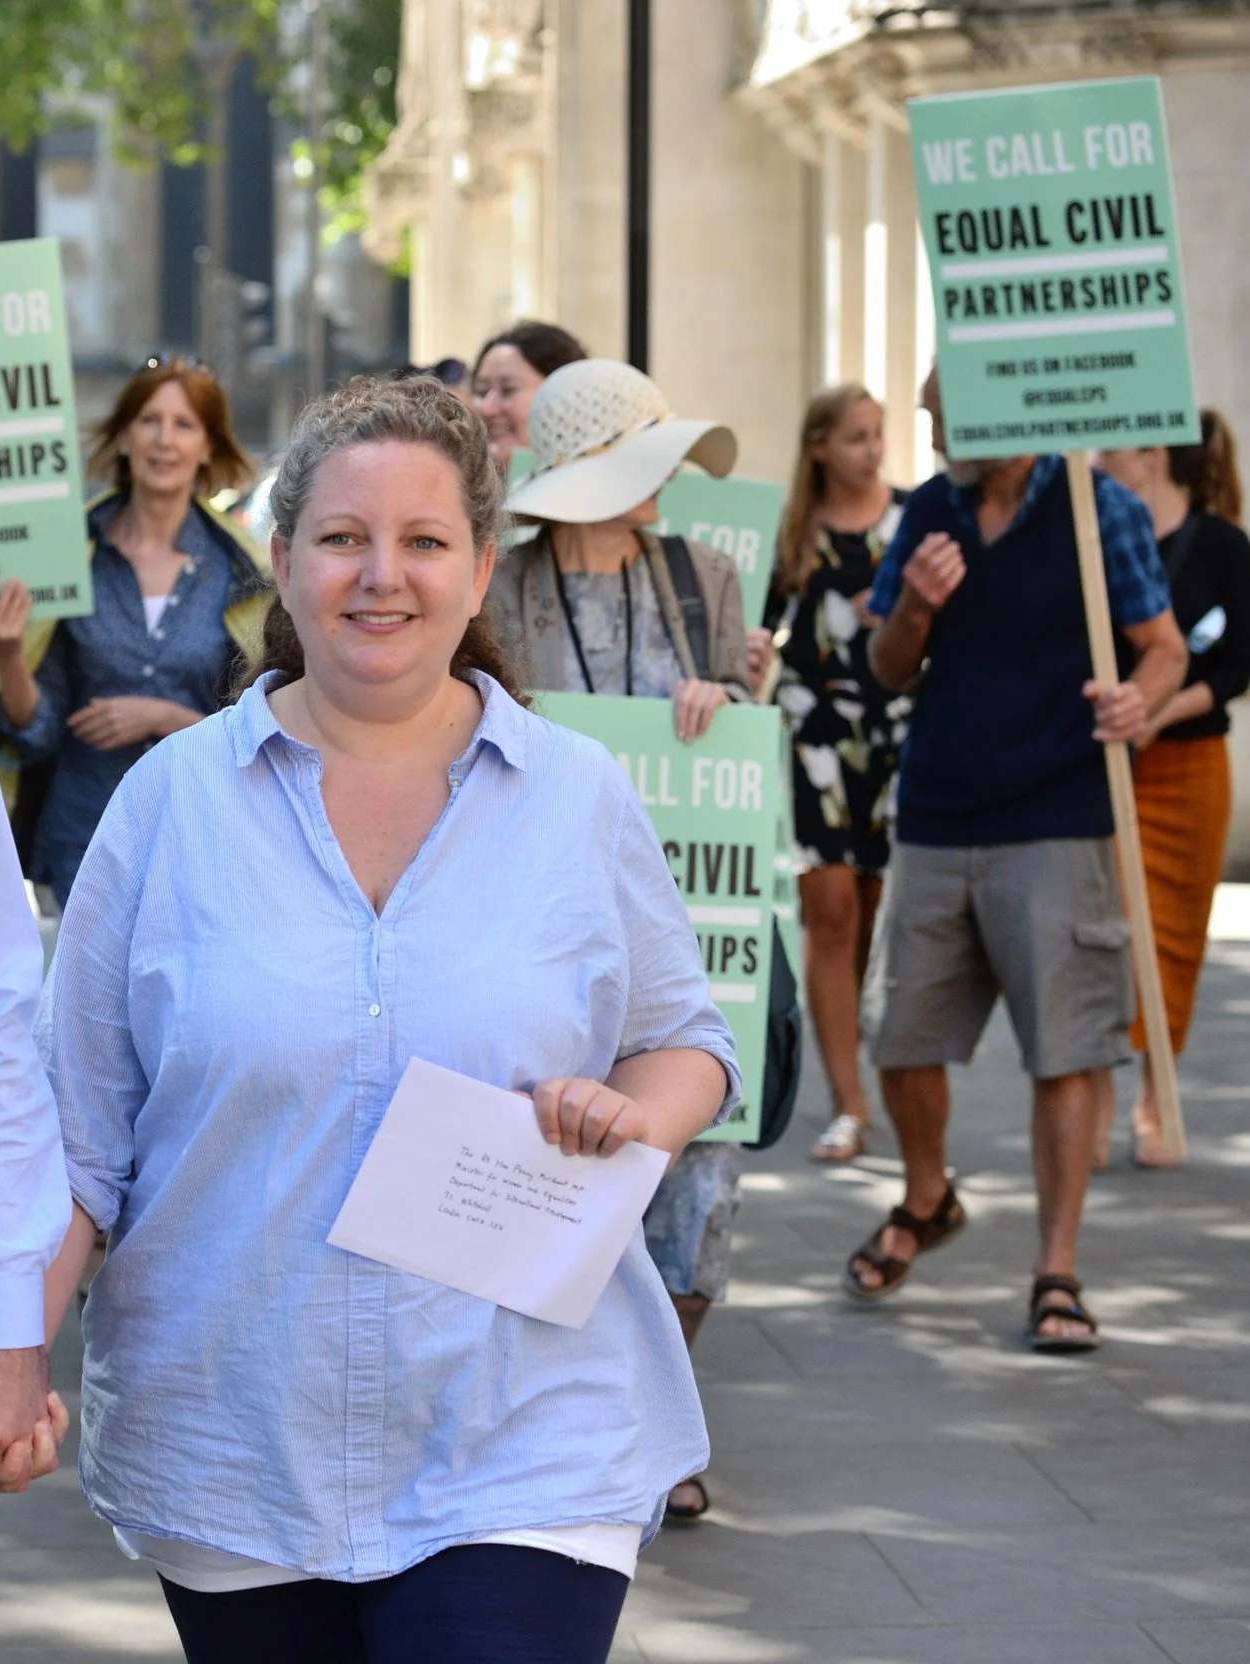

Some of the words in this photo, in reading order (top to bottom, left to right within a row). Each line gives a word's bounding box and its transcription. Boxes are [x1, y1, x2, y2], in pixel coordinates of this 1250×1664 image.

[921, 138, 977, 185] WE
[985, 130, 1076, 179] CALL
[1084, 121, 1155, 170] FOR
[935, 205, 1052, 255] EQUAL
[1065, 192, 1165, 244] CIVIL
[944, 271, 1174, 321] PARTNERSHIPS
[692, 757, 763, 811] FOR
